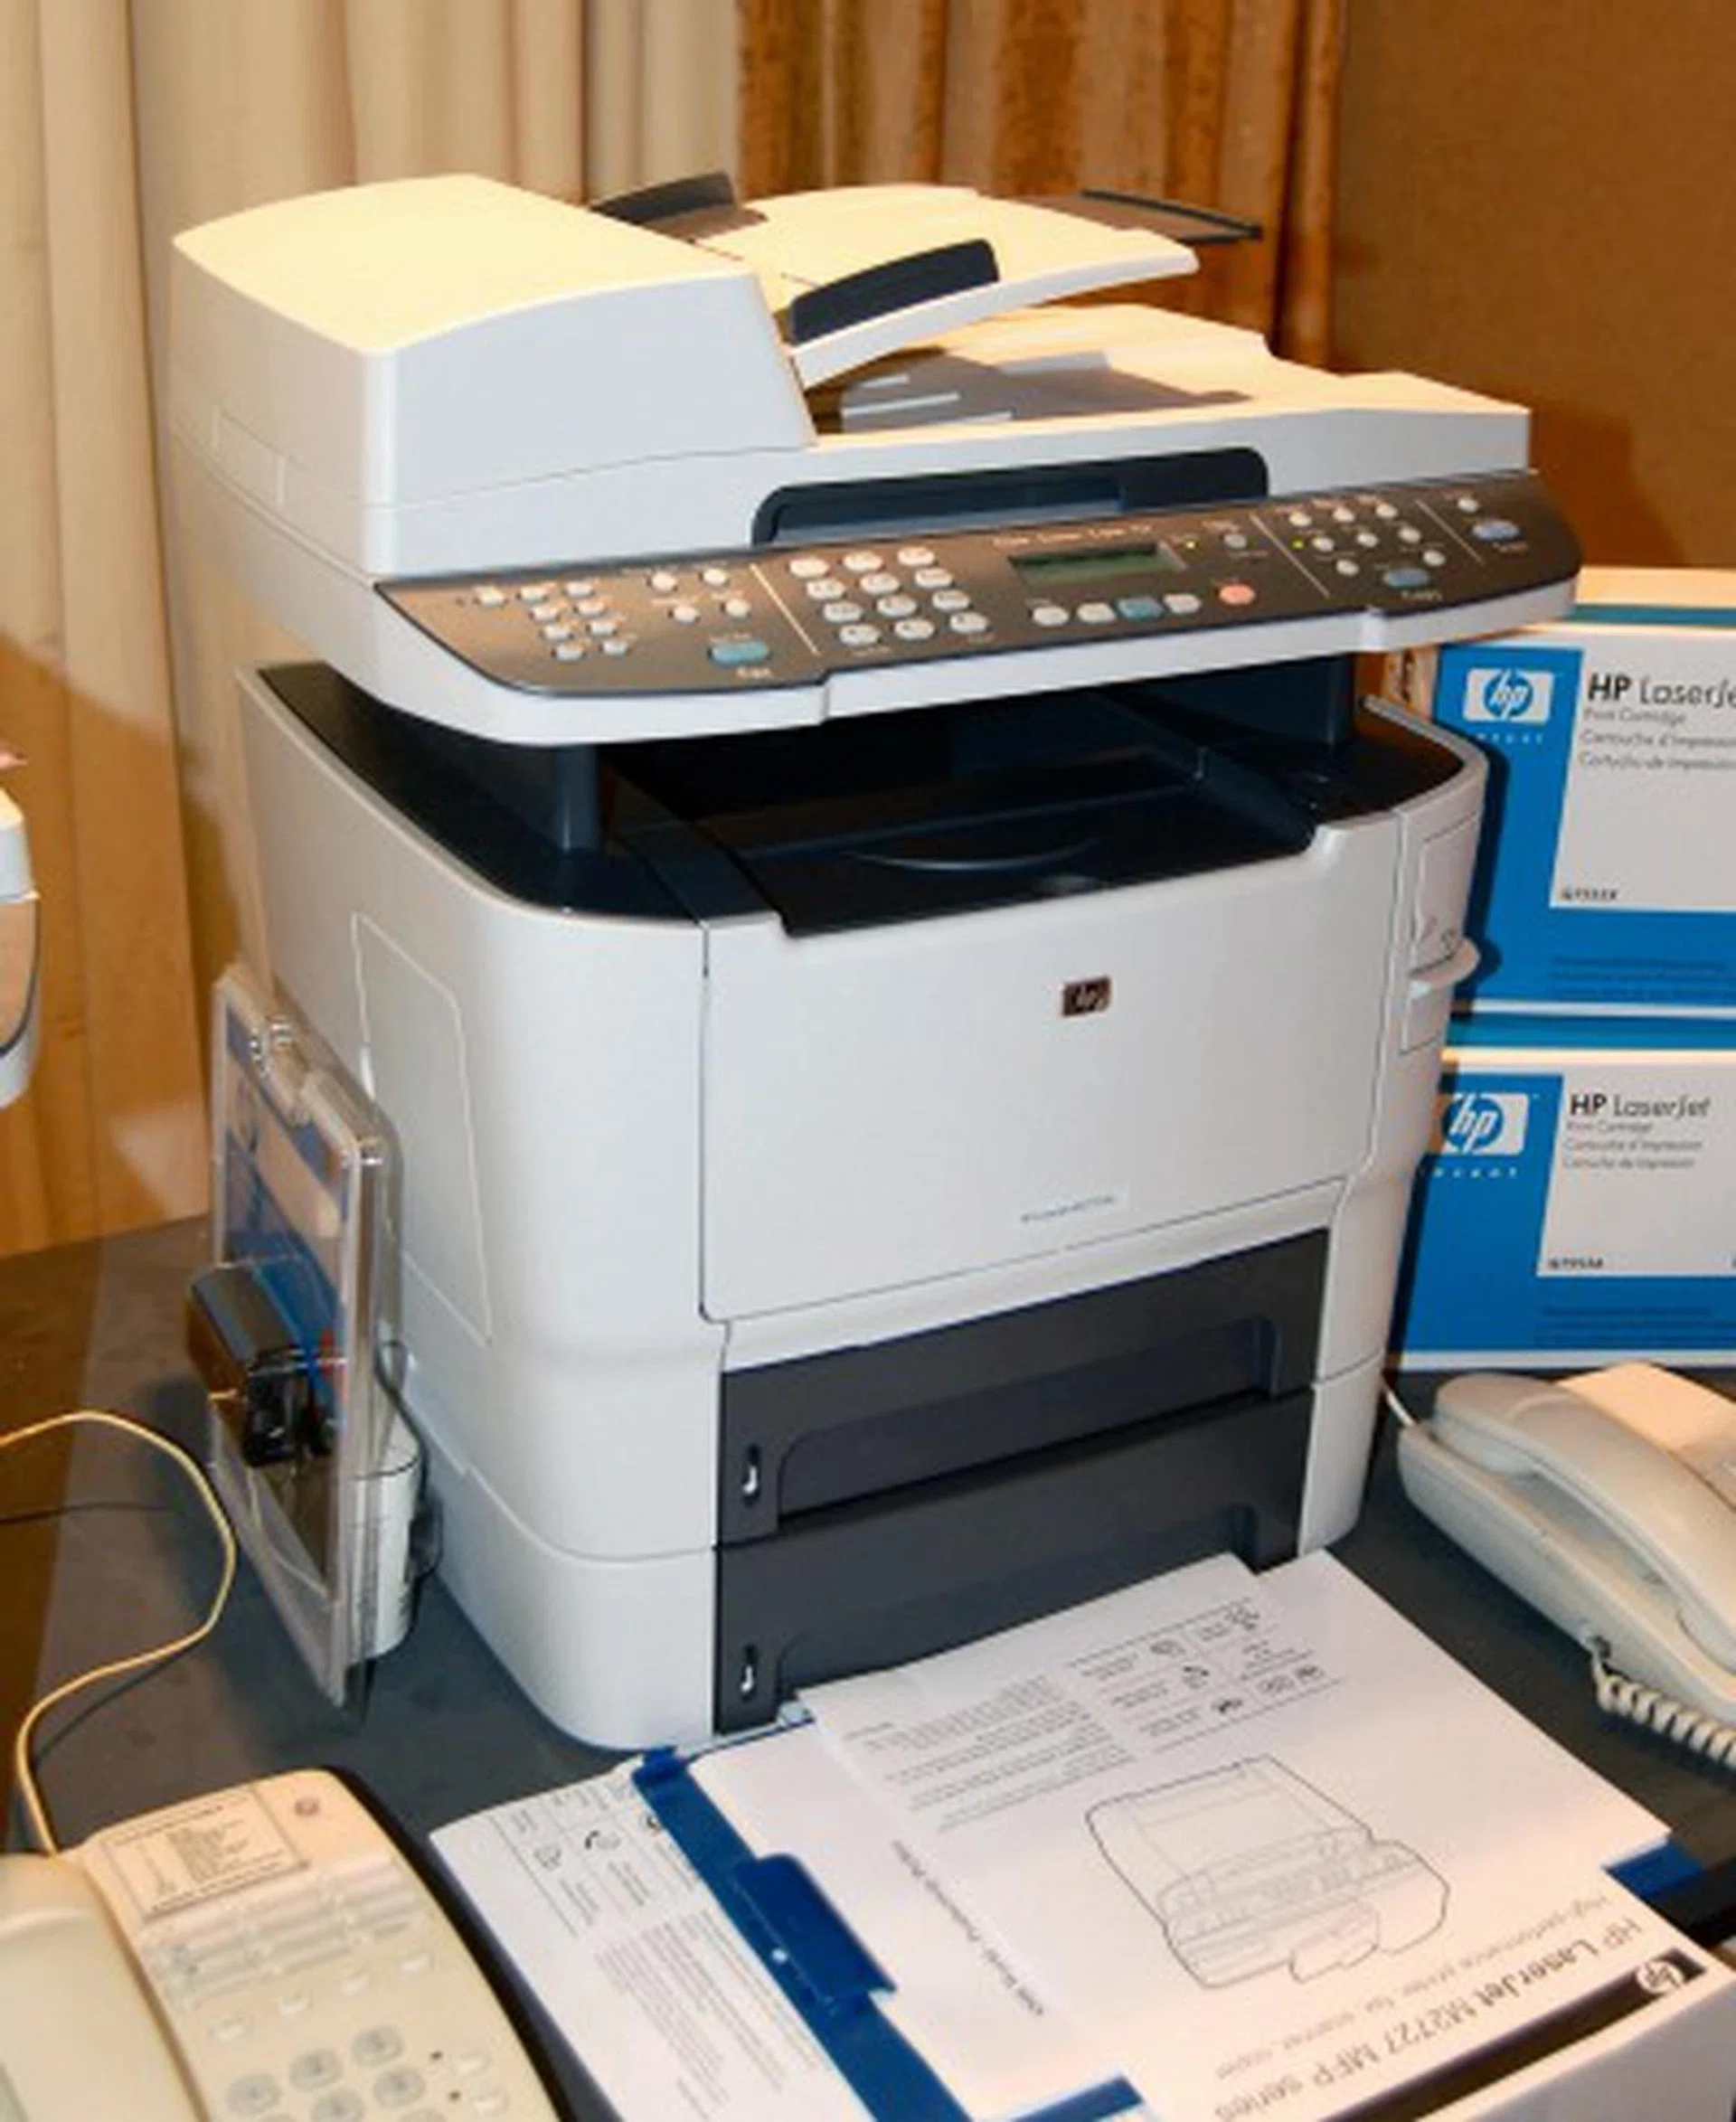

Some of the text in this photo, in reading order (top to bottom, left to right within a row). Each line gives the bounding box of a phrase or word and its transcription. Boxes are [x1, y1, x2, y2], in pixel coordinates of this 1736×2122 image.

[1588, 673, 1631, 701] HP
[1571, 1093, 1712, 1121] HP LaserJet
[1214, 1916, 1643, 2122] HP LaserJet M2727 MFP series
